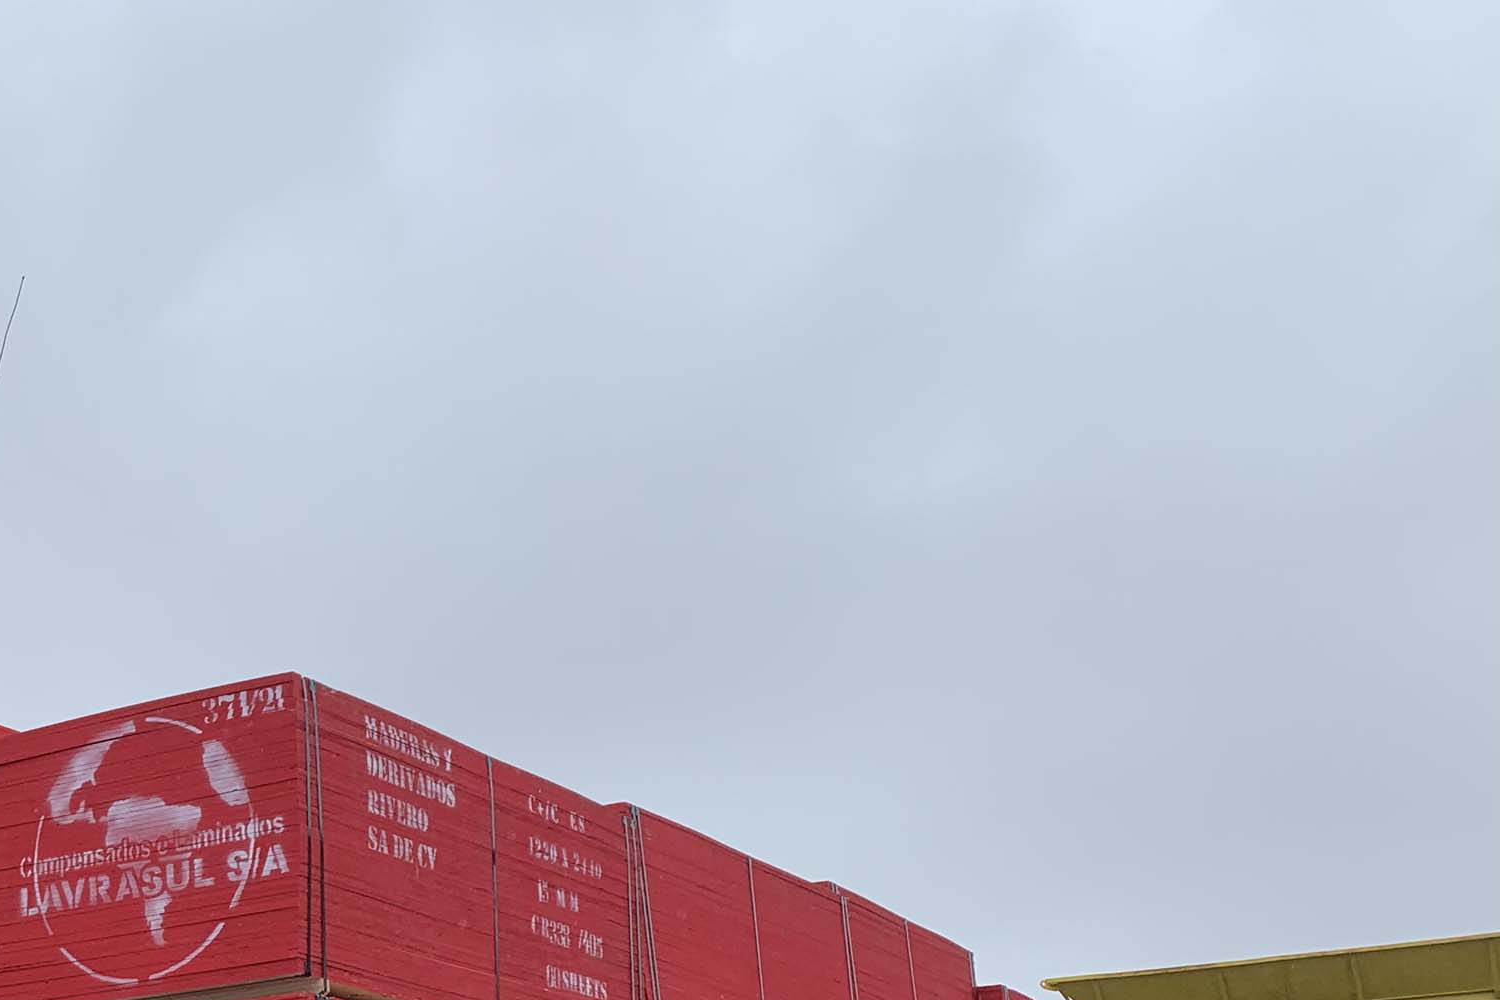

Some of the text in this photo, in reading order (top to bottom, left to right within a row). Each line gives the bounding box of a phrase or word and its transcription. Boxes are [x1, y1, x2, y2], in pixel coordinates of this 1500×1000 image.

[202, 685, 285, 723] 371/21
[364, 715, 440, 767] MADERAS
[365, 750, 456, 807] DERIVADOS
[367, 790, 429, 832] RIVERO
[367, 826, 437, 871] SA DE CV
[20, 844, 290, 917] LAVRASUL S/A
